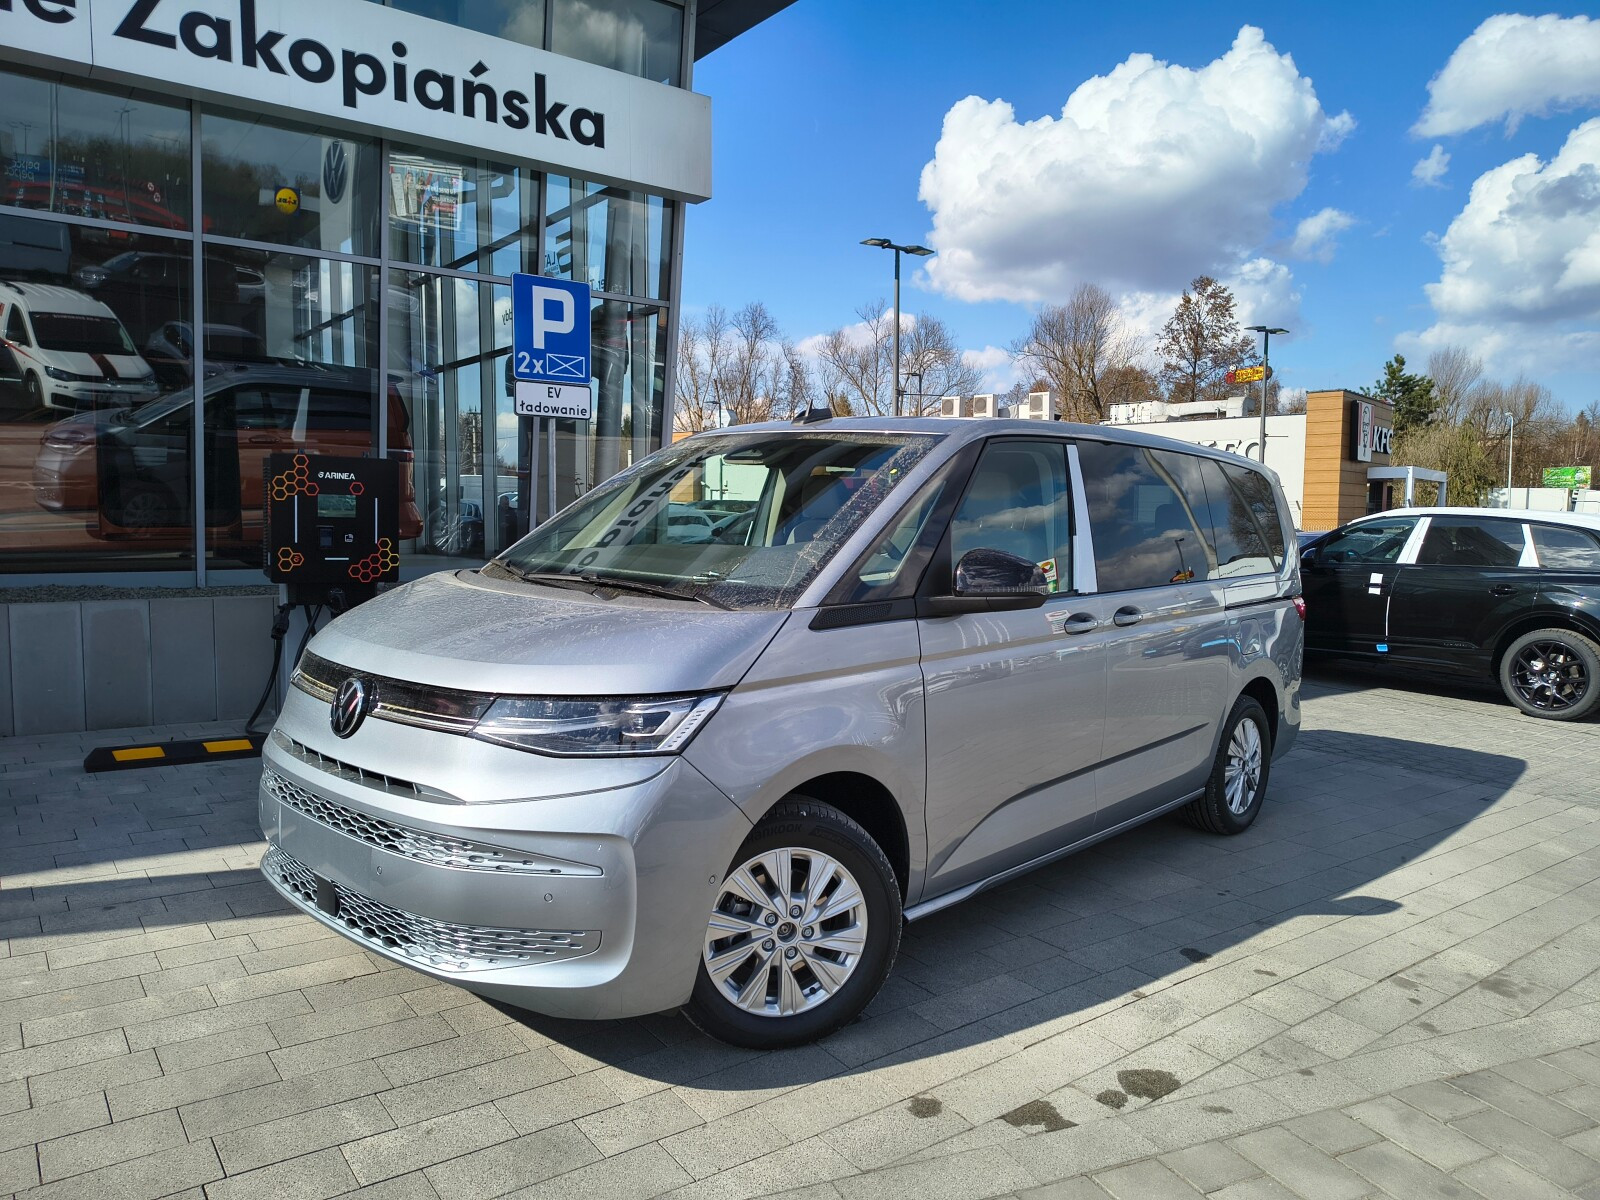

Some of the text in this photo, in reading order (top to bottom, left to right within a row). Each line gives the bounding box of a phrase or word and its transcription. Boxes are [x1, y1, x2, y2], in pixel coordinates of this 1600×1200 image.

[112, 0, 605, 149] Zakopiańska
[532, 285, 575, 350] P
[517, 351, 544, 375] 2x
[547, 386, 562, 399] EV
[519, 400, 588, 417] ładowanie
[1372, 425, 1394, 455] KFC
[324, 472, 356, 481] ARINEA
